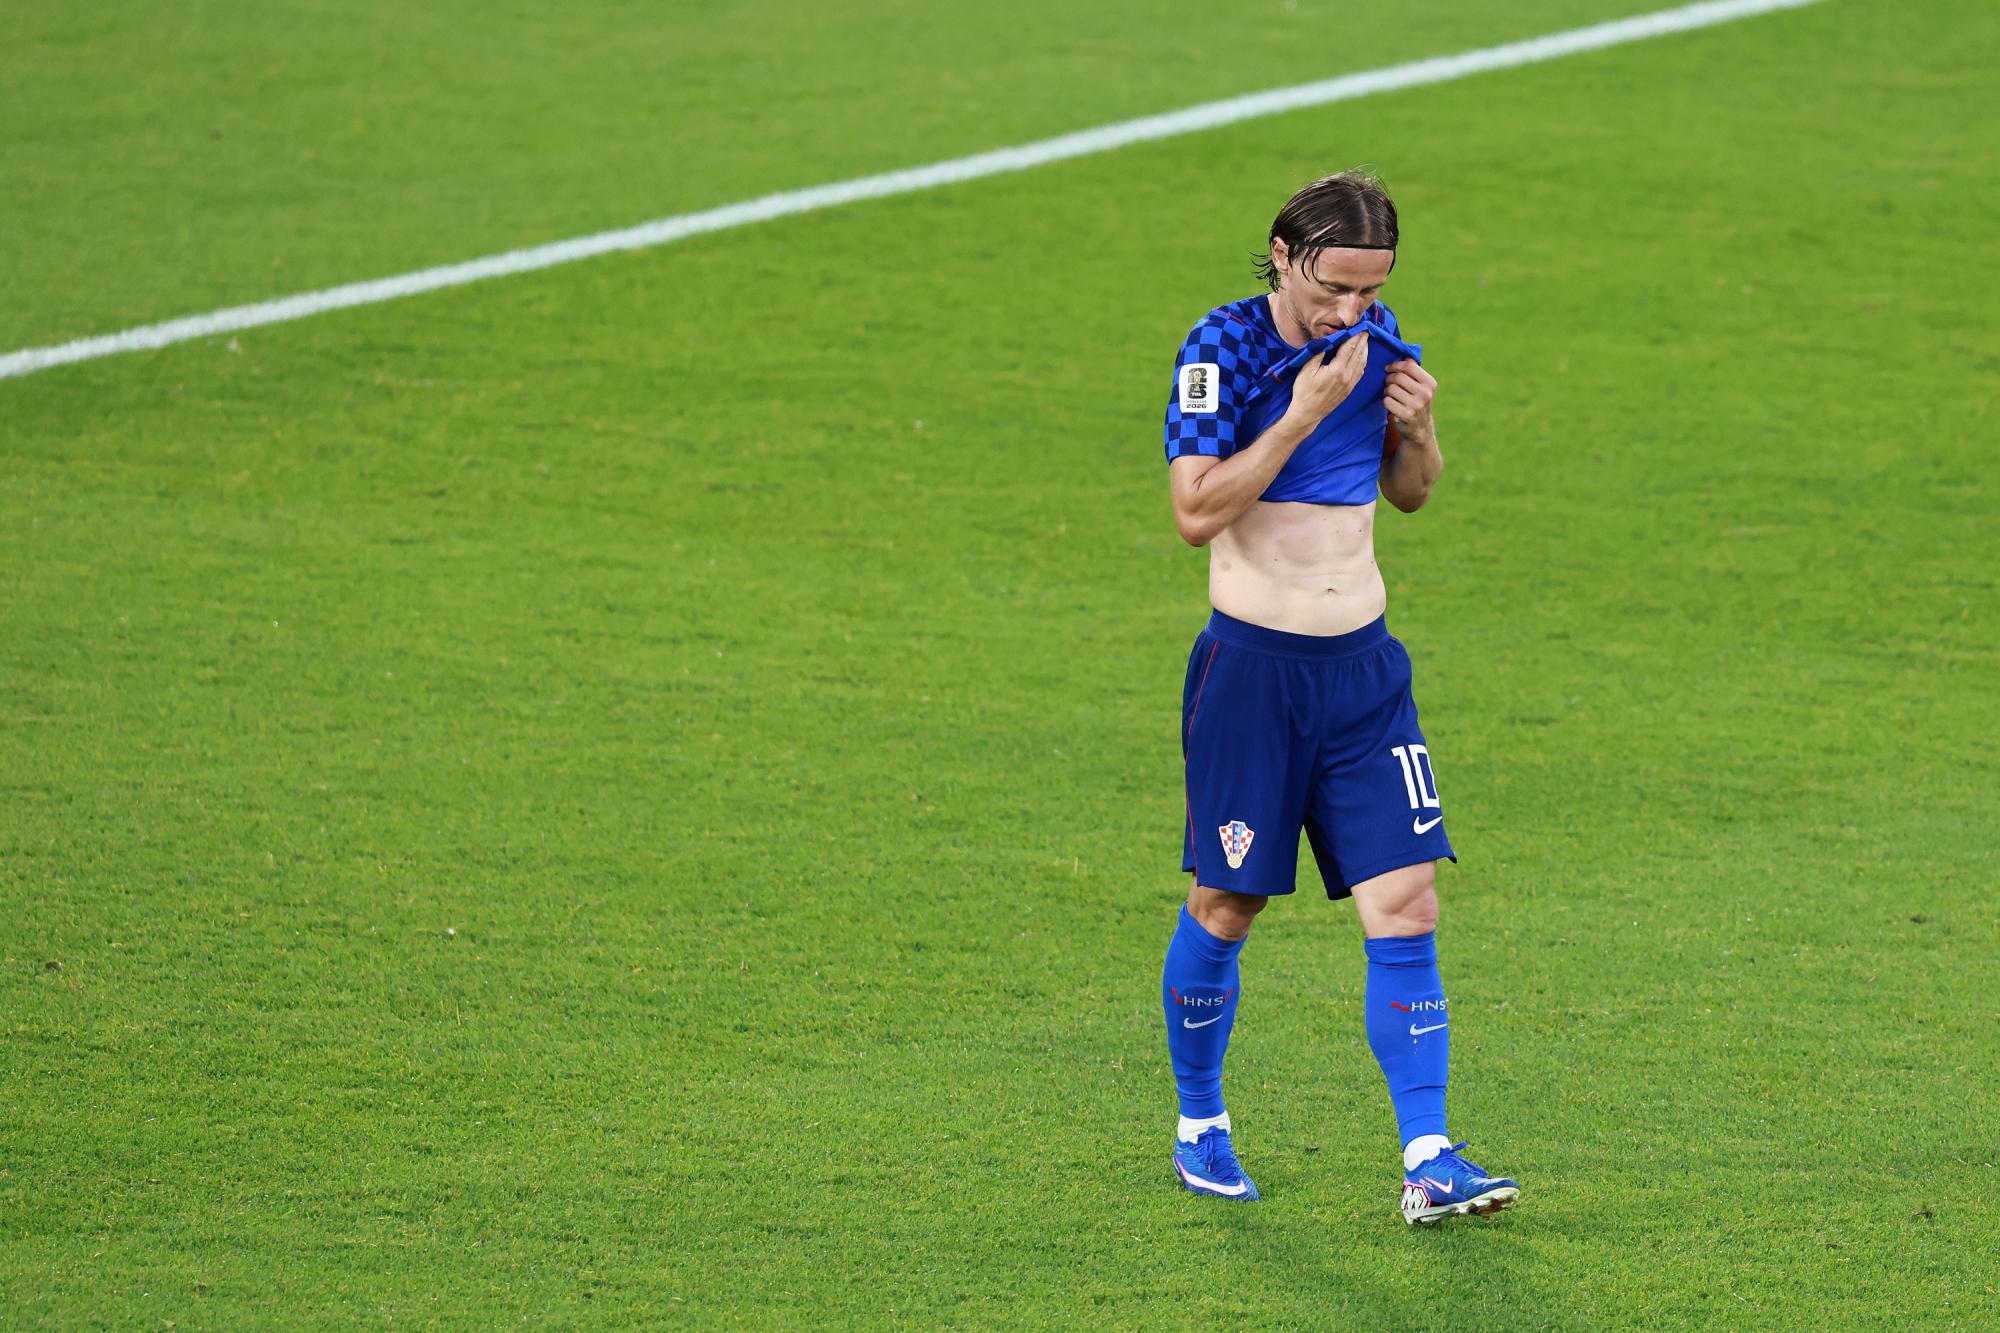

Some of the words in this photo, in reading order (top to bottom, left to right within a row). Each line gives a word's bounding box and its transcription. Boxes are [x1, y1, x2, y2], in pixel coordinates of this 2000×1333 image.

[1391, 744, 1440, 809] 10
[1183, 995, 1224, 1008] HNS
[1411, 999, 1446, 1012] HNS
